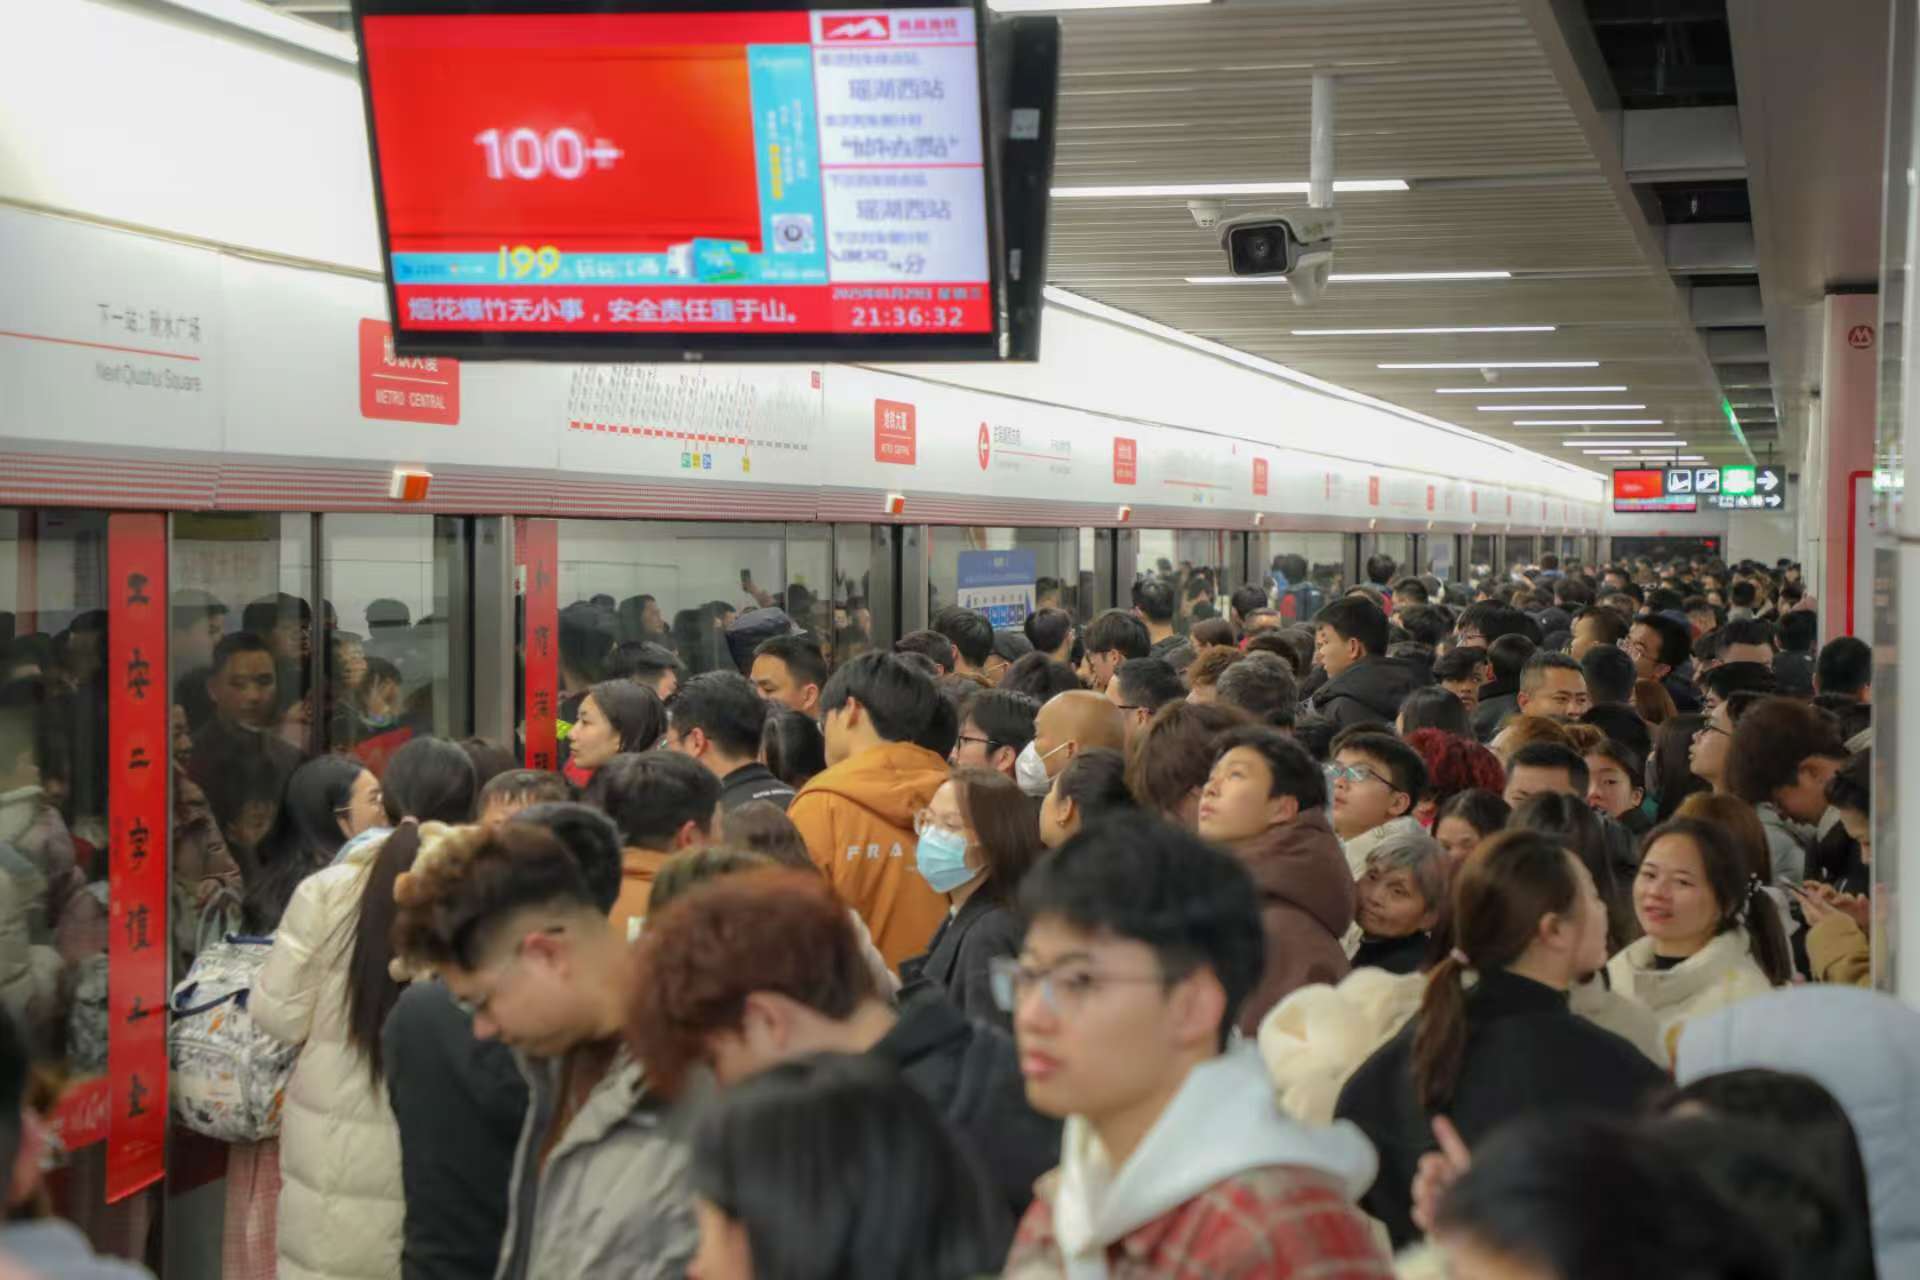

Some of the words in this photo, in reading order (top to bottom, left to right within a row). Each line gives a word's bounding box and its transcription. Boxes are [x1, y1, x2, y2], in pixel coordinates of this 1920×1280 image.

[474, 128, 624, 180] 100+
[497, 245, 561, 279] 199
[408, 297, 797, 323] 烟花爆竹无小事，安全责任重于山。
[851, 306, 964, 328] 21:36:32
[375, 388, 405, 406] METRO
[408, 391, 447, 409] CENTRAL
